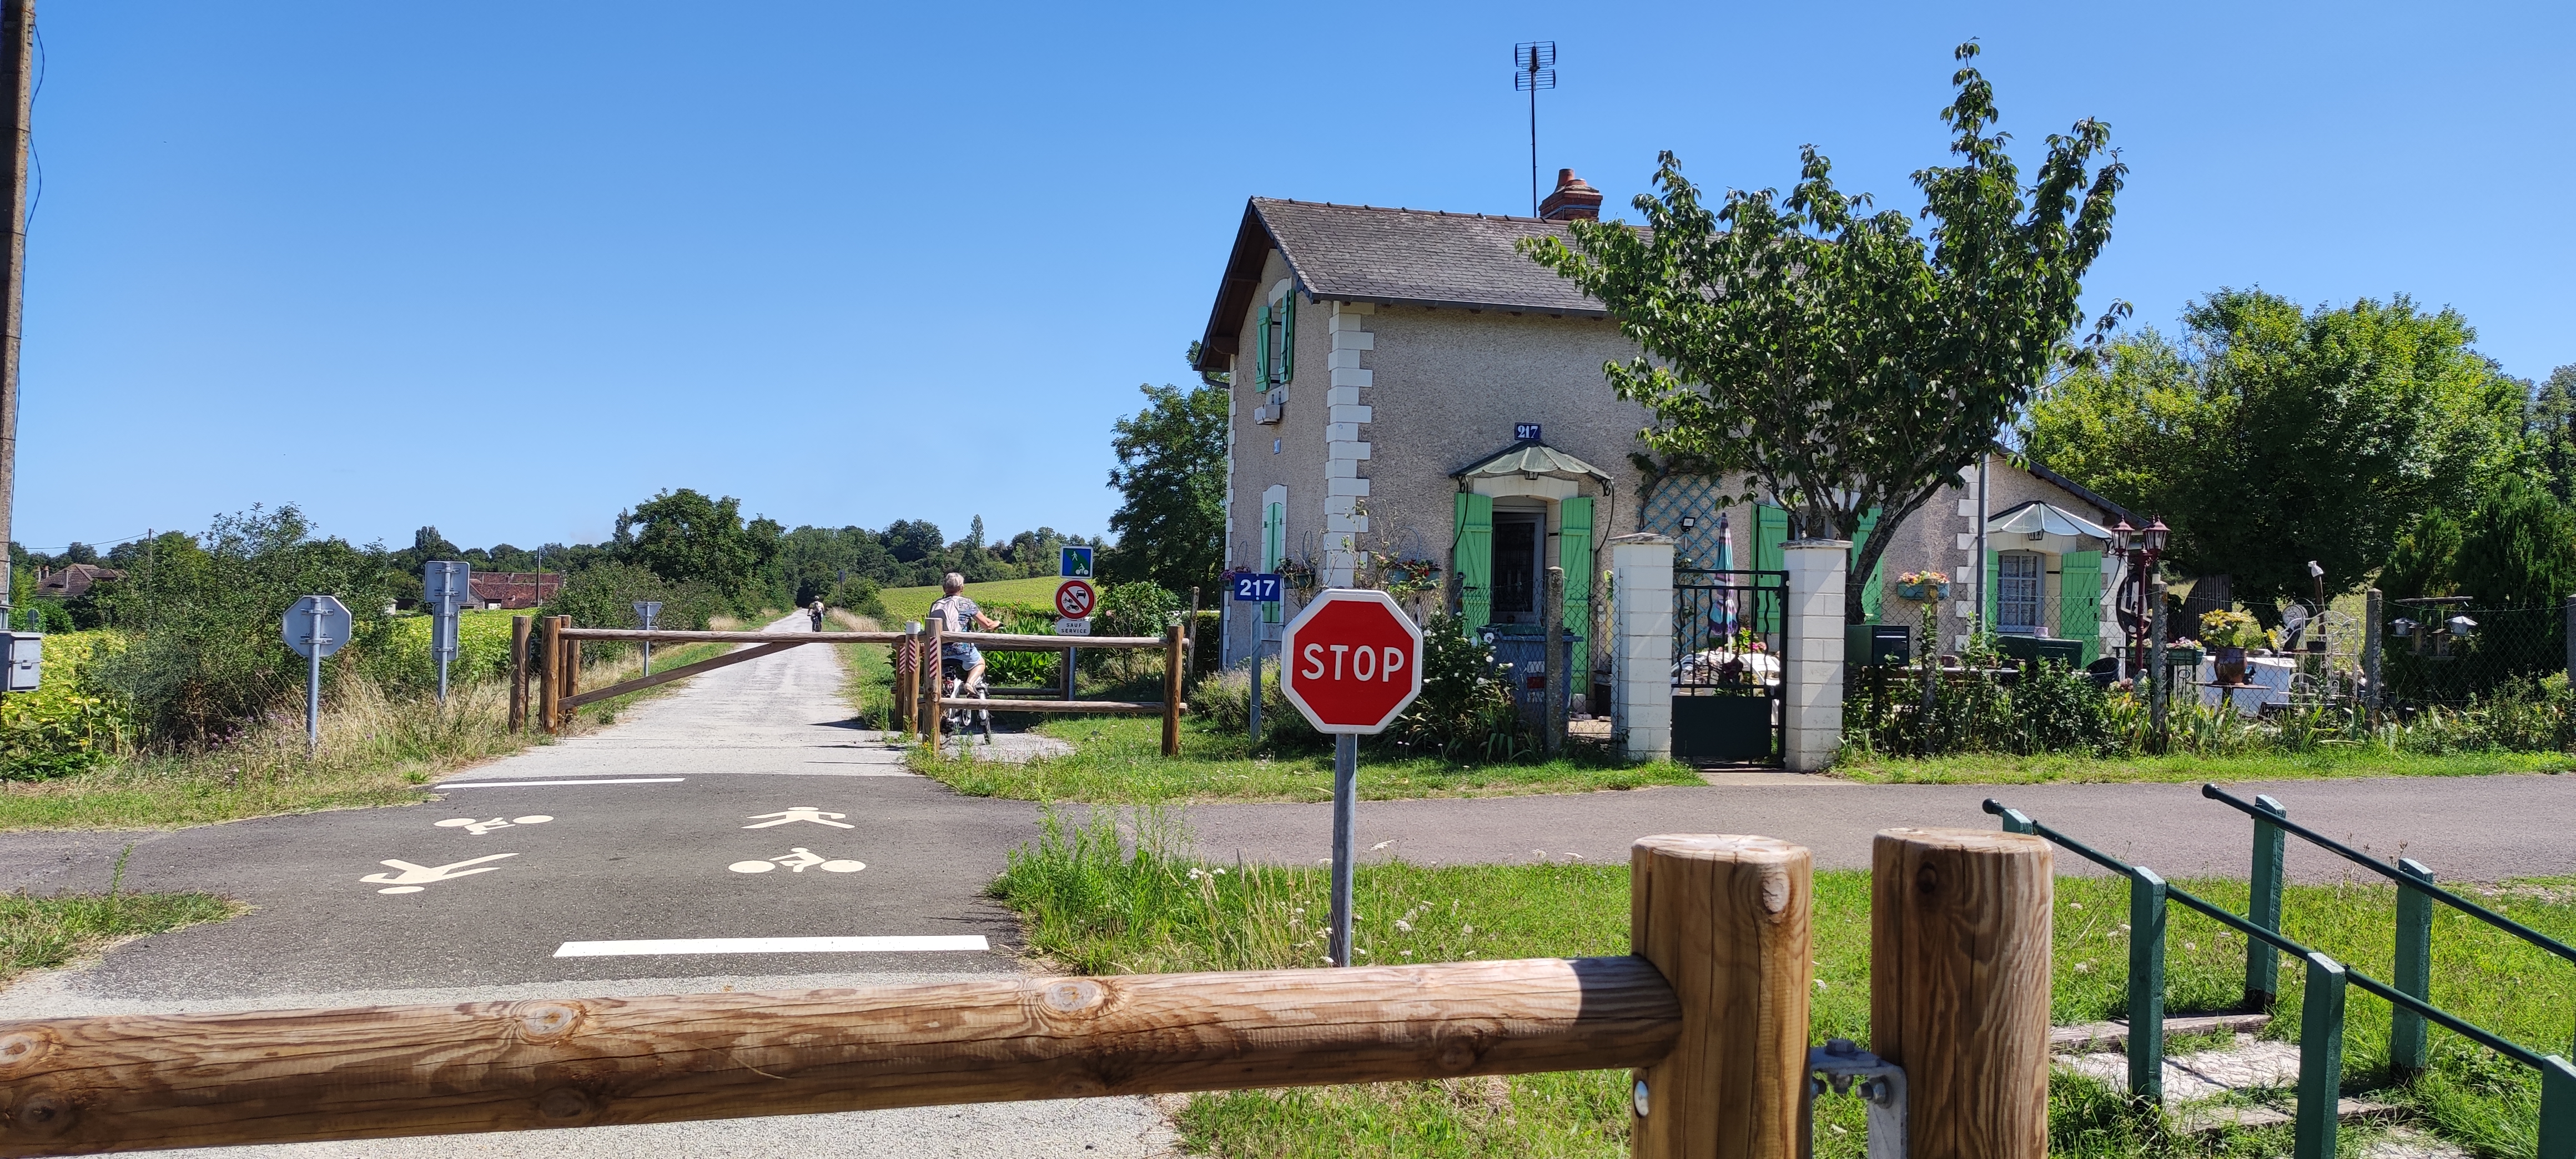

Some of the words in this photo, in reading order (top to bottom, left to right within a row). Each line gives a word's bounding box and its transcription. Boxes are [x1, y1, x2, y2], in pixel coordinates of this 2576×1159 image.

[1517, 425, 1538, 439] 217
[1240, 579, 1275, 596] 217
[1301, 643, 1405, 682] STOP
